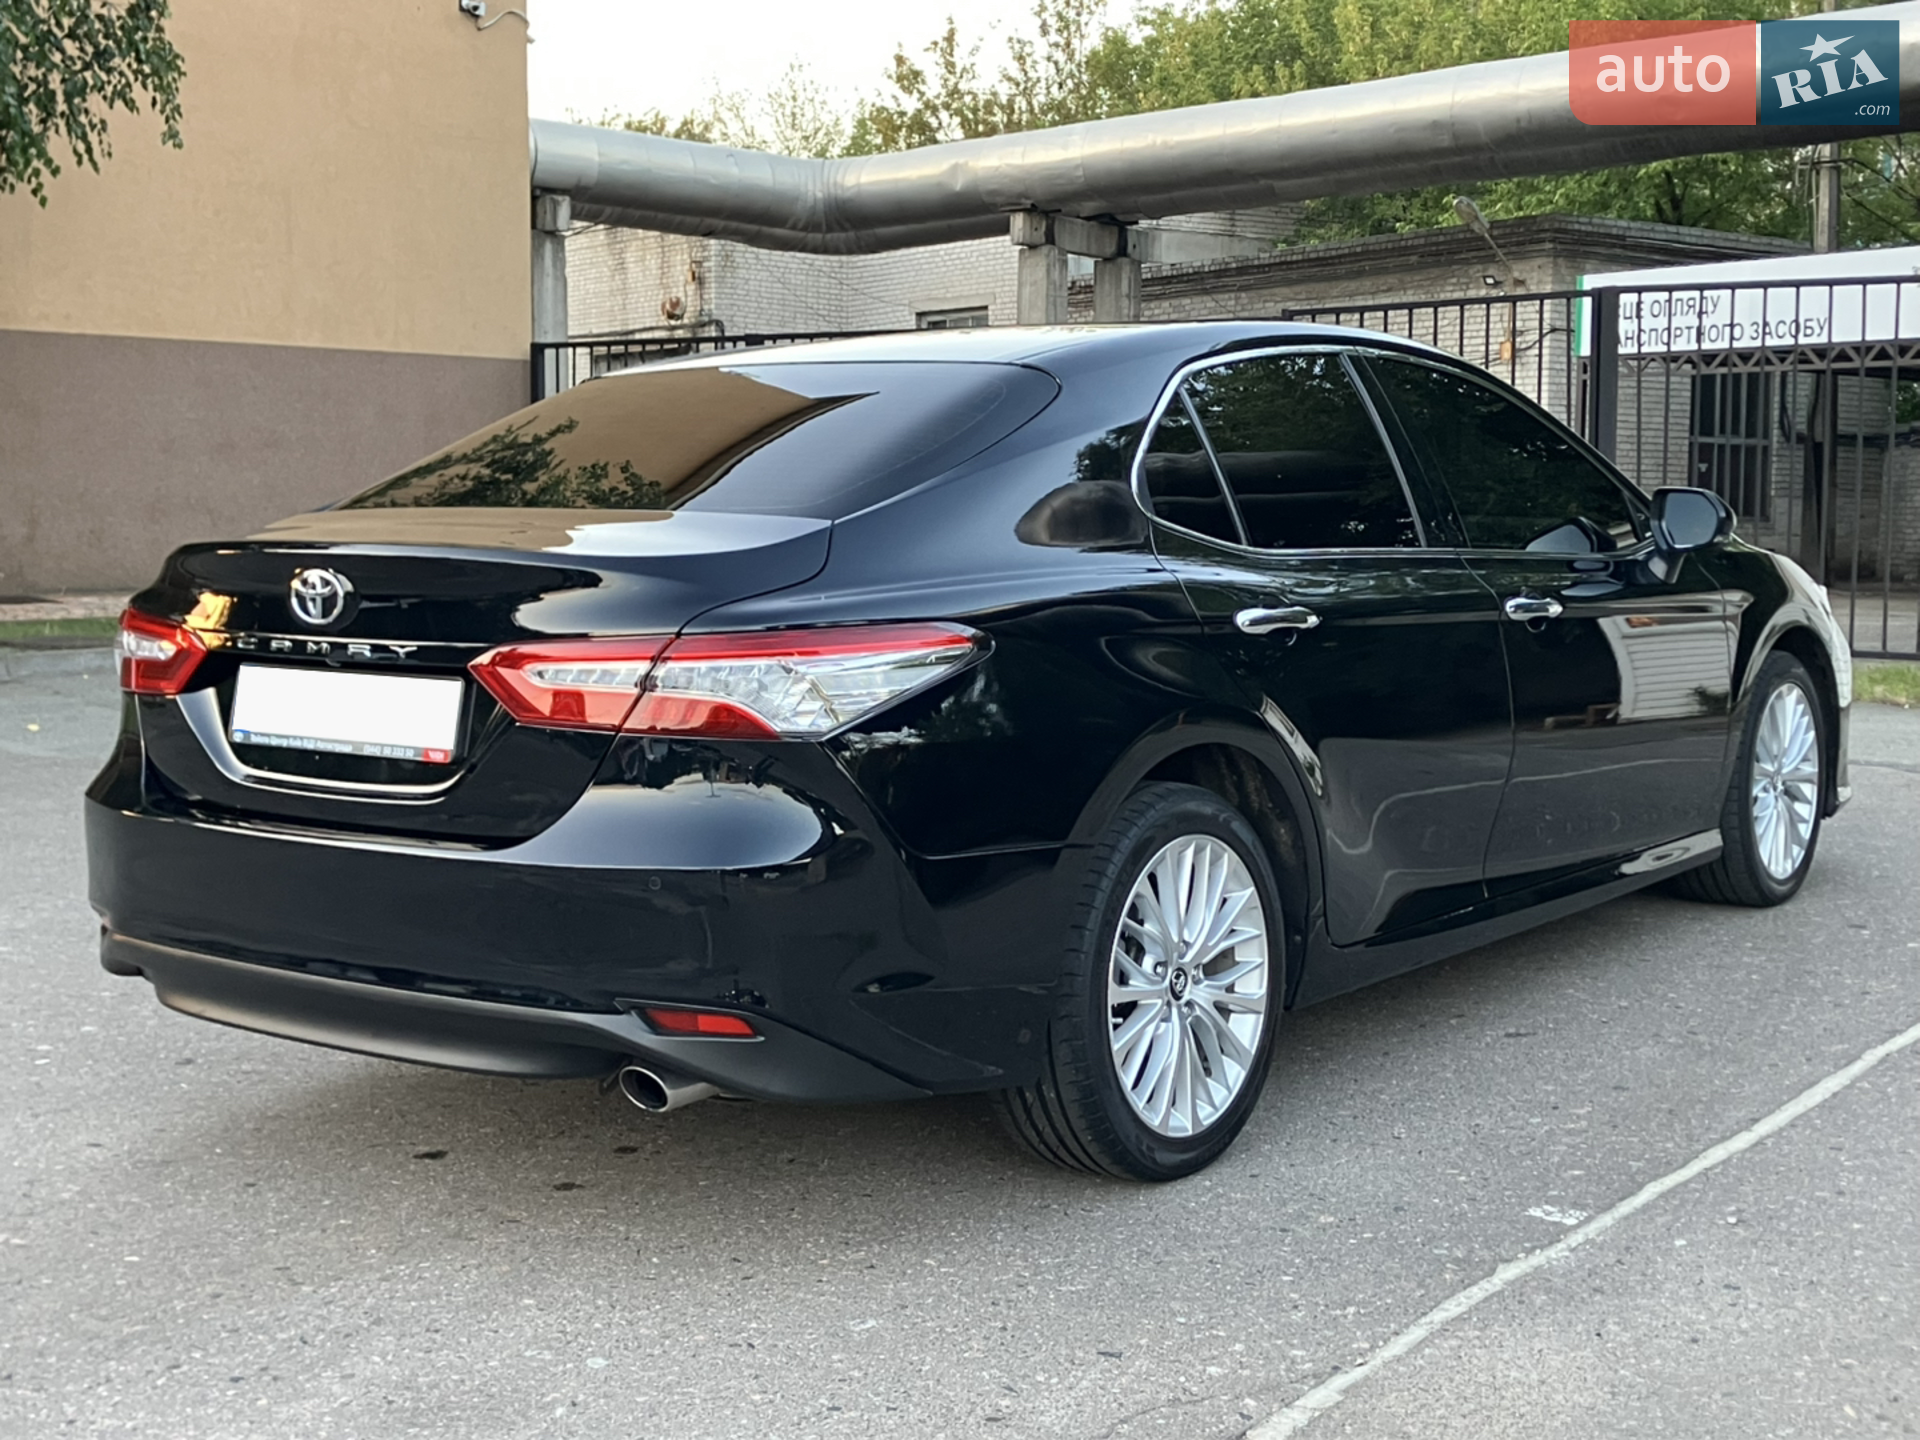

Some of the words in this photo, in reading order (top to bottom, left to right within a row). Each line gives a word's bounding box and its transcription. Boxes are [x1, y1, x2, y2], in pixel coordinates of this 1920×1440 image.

[1618, 300, 1644, 324] ЦЕ
[1650, 295, 1721, 319] ОГЛЯДУ
[1618, 322, 1744, 348] НСПОРТНОГО
[1750, 316, 1828, 341] ЗАСОБУ
[237, 637, 418, 659] CAMRY
